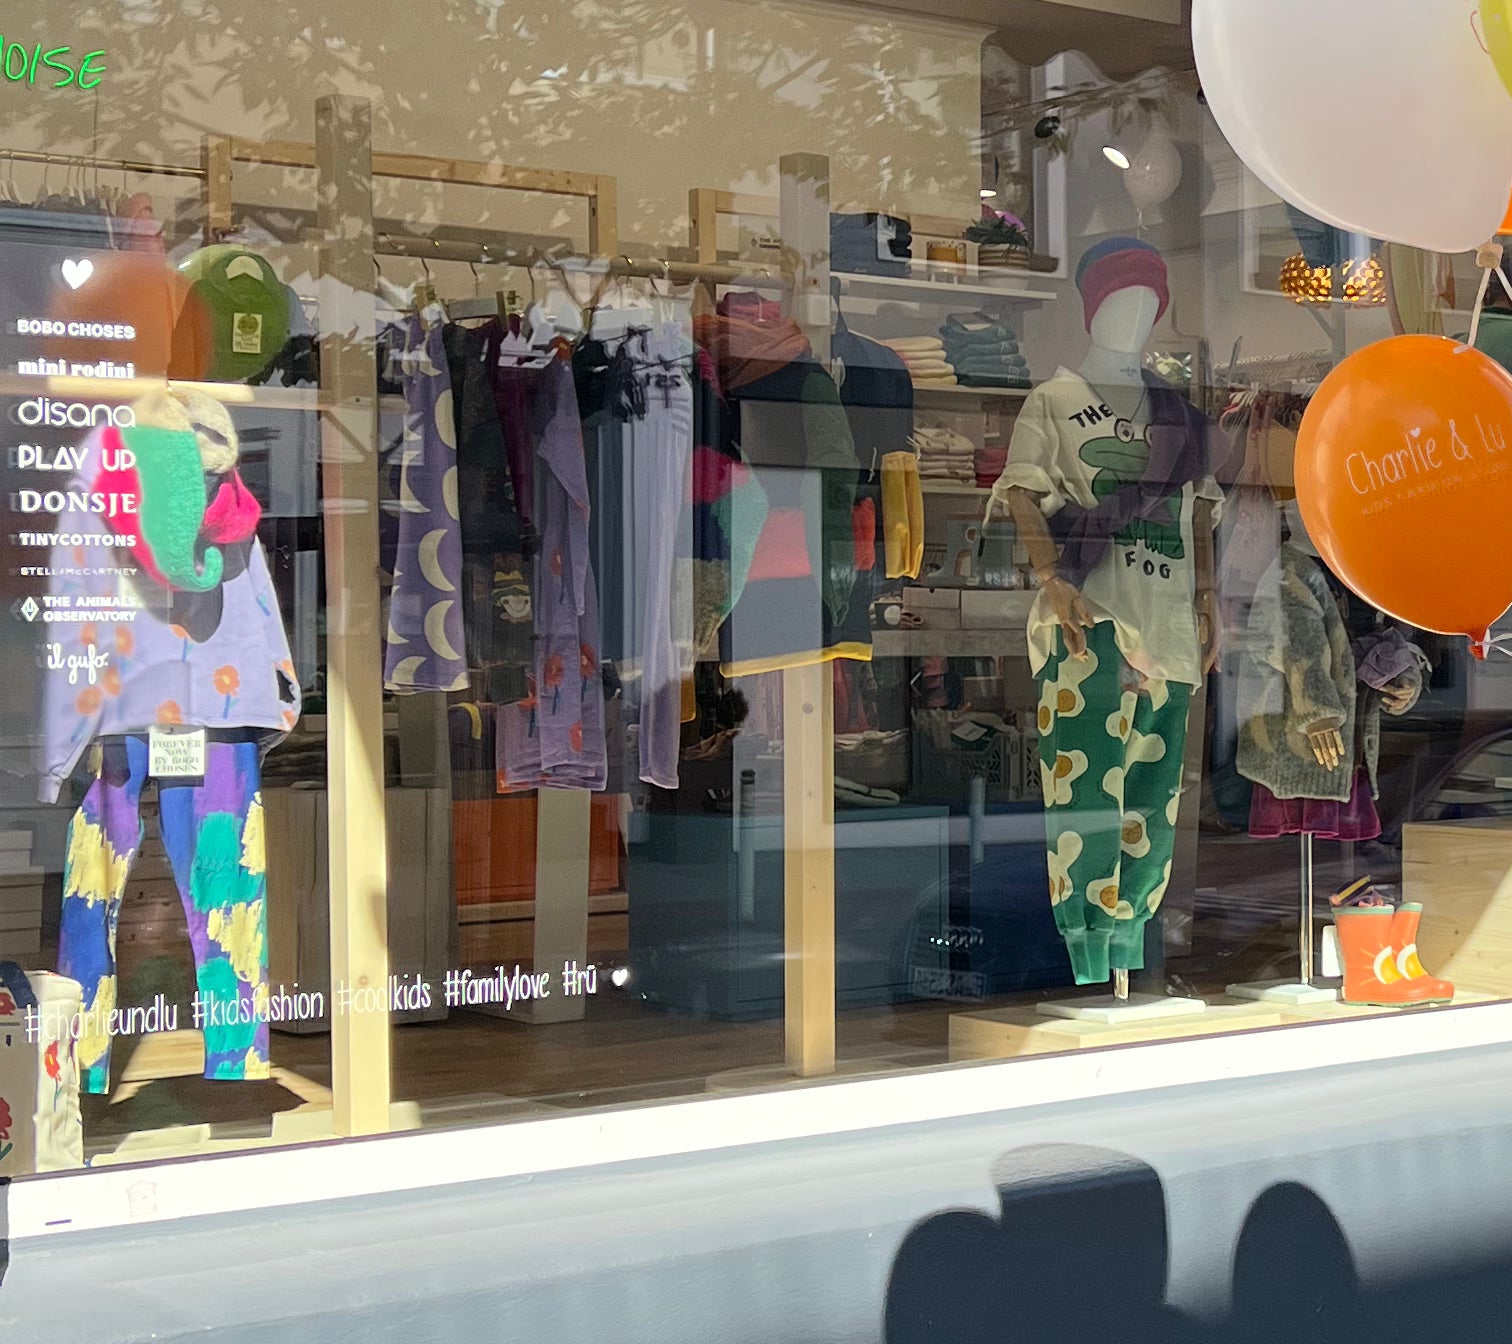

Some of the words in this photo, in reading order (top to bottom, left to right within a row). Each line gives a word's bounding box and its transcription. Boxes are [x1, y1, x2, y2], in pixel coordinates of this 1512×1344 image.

[17, 319, 66, 336] BOBO
[68, 322, 136, 340] CHOSES
[18, 358, 67, 377] mini
[71, 360, 135, 379] rodini
[18, 397, 136, 428] disana
[1068, 404, 1114, 428] THE
[18, 444, 89, 470] PLAY
[102, 447, 137, 471] UP
[1344, 427, 1443, 496] Charlie
[1448, 418, 1473, 462] &
[1474, 414, 1507, 453] Lu
[19, 490, 138, 517] DONSJE
[19, 533, 137, 547] TINYCOTTONS
[42, 596, 71, 607] THE
[75, 596, 137, 608] ANIMALS
[42, 610, 137, 622] OBSERVATORY
[47, 642, 66, 669] il
[24, 993, 178, 1044] #charlieundlu
[191, 983, 324, 1029] #kidsfashion
[336, 973, 432, 1017] #coolkids
[443, 963, 551, 1011] #familylove
